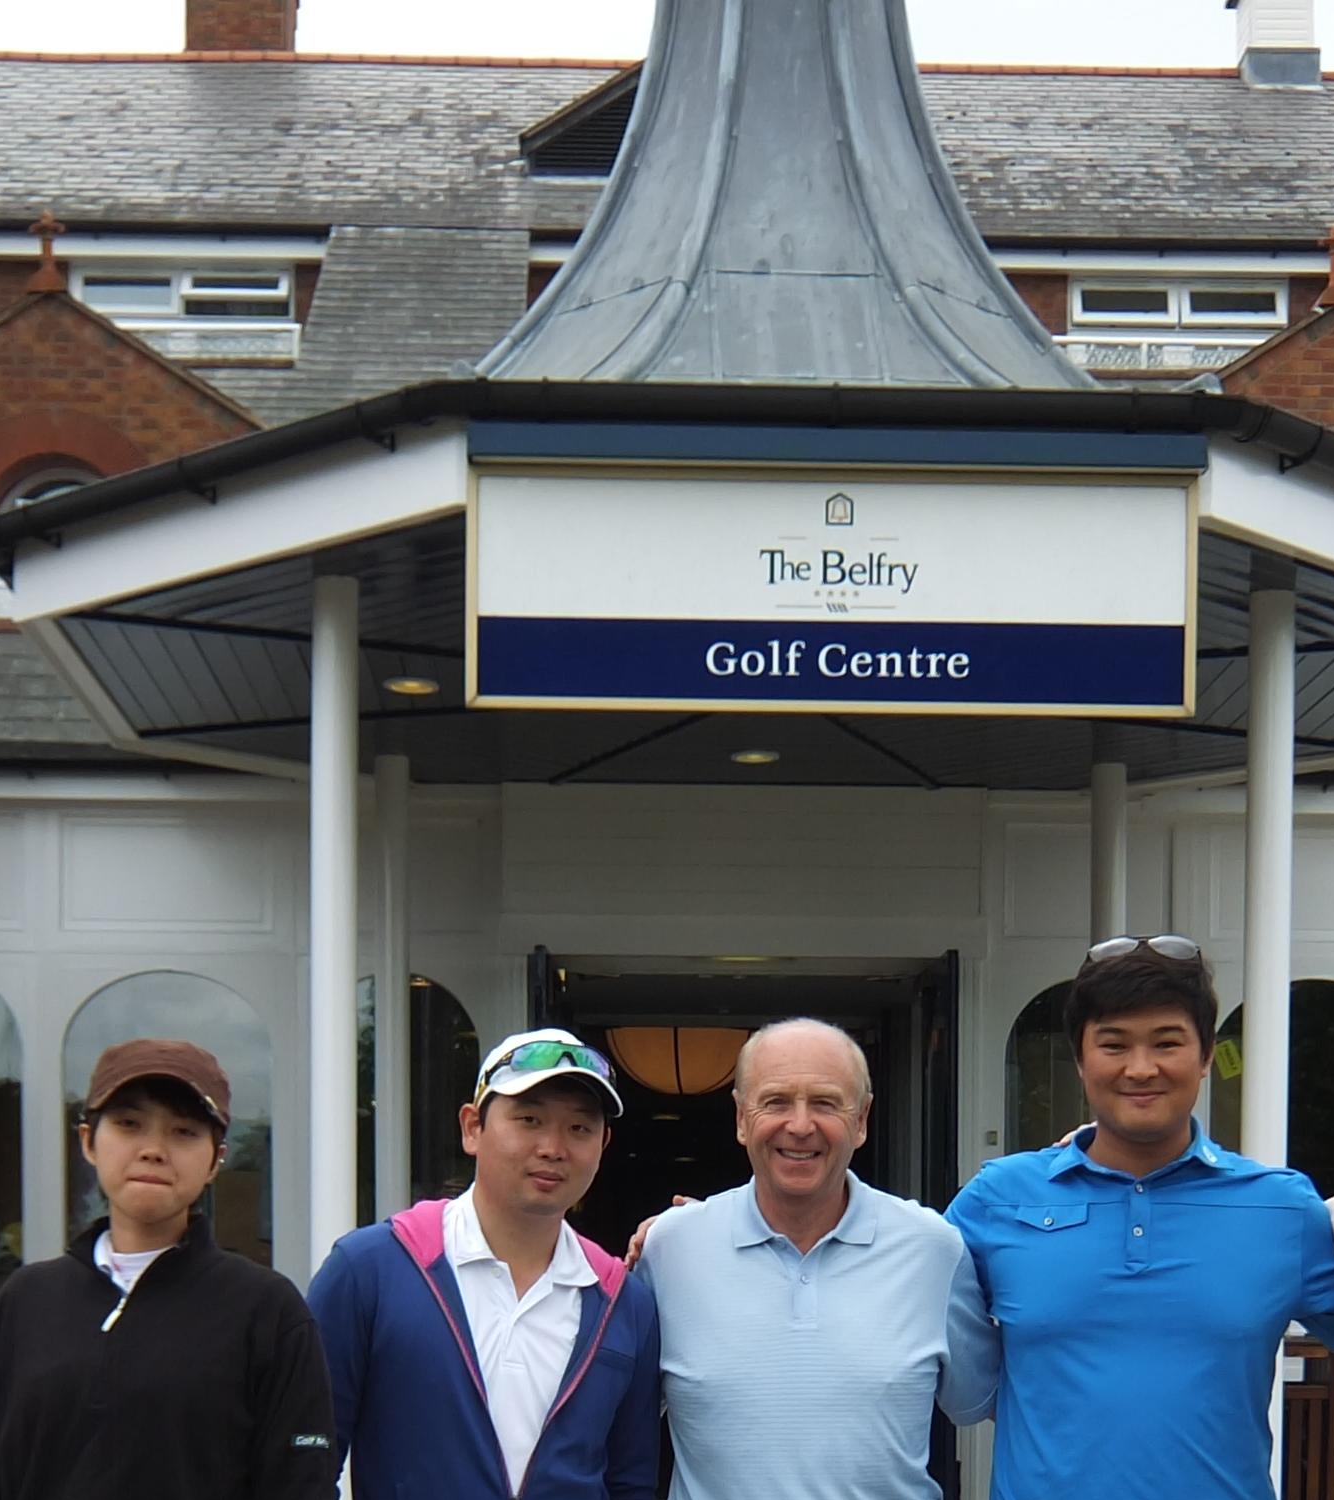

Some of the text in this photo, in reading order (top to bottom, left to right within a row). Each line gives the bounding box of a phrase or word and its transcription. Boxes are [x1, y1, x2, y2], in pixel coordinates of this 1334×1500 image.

[759, 549, 919, 595] The Belfry
[705, 639, 970, 679] Golf Centre
